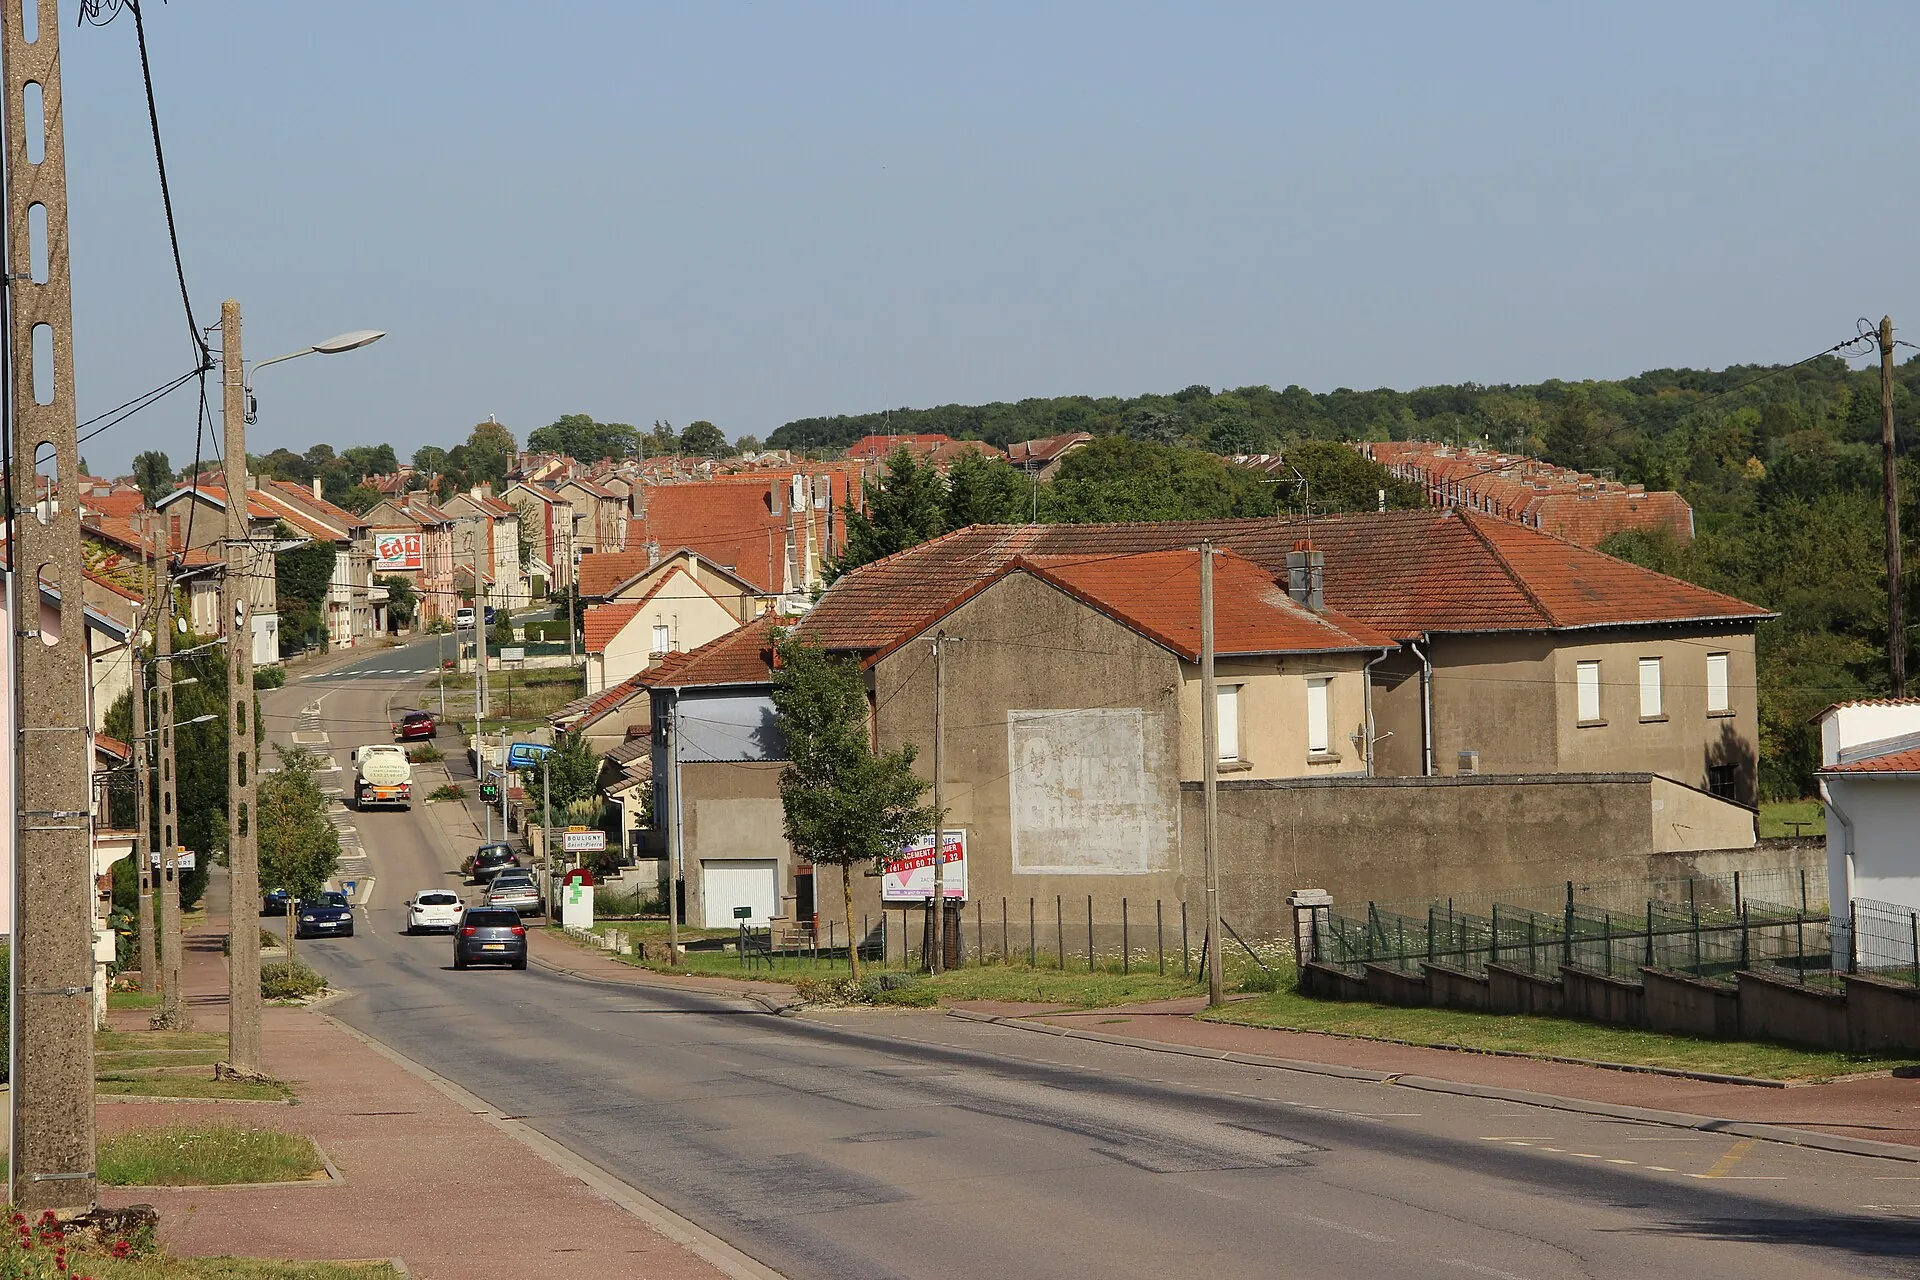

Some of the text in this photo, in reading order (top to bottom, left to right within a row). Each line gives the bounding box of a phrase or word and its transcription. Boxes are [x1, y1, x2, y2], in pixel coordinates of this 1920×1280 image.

[379, 539, 404, 560] Ed
[483, 786, 495, 795] 44
[923, 837, 956, 845] PIENES
[915, 859, 925, 867] 60
[949, 853, 959, 861] 32
